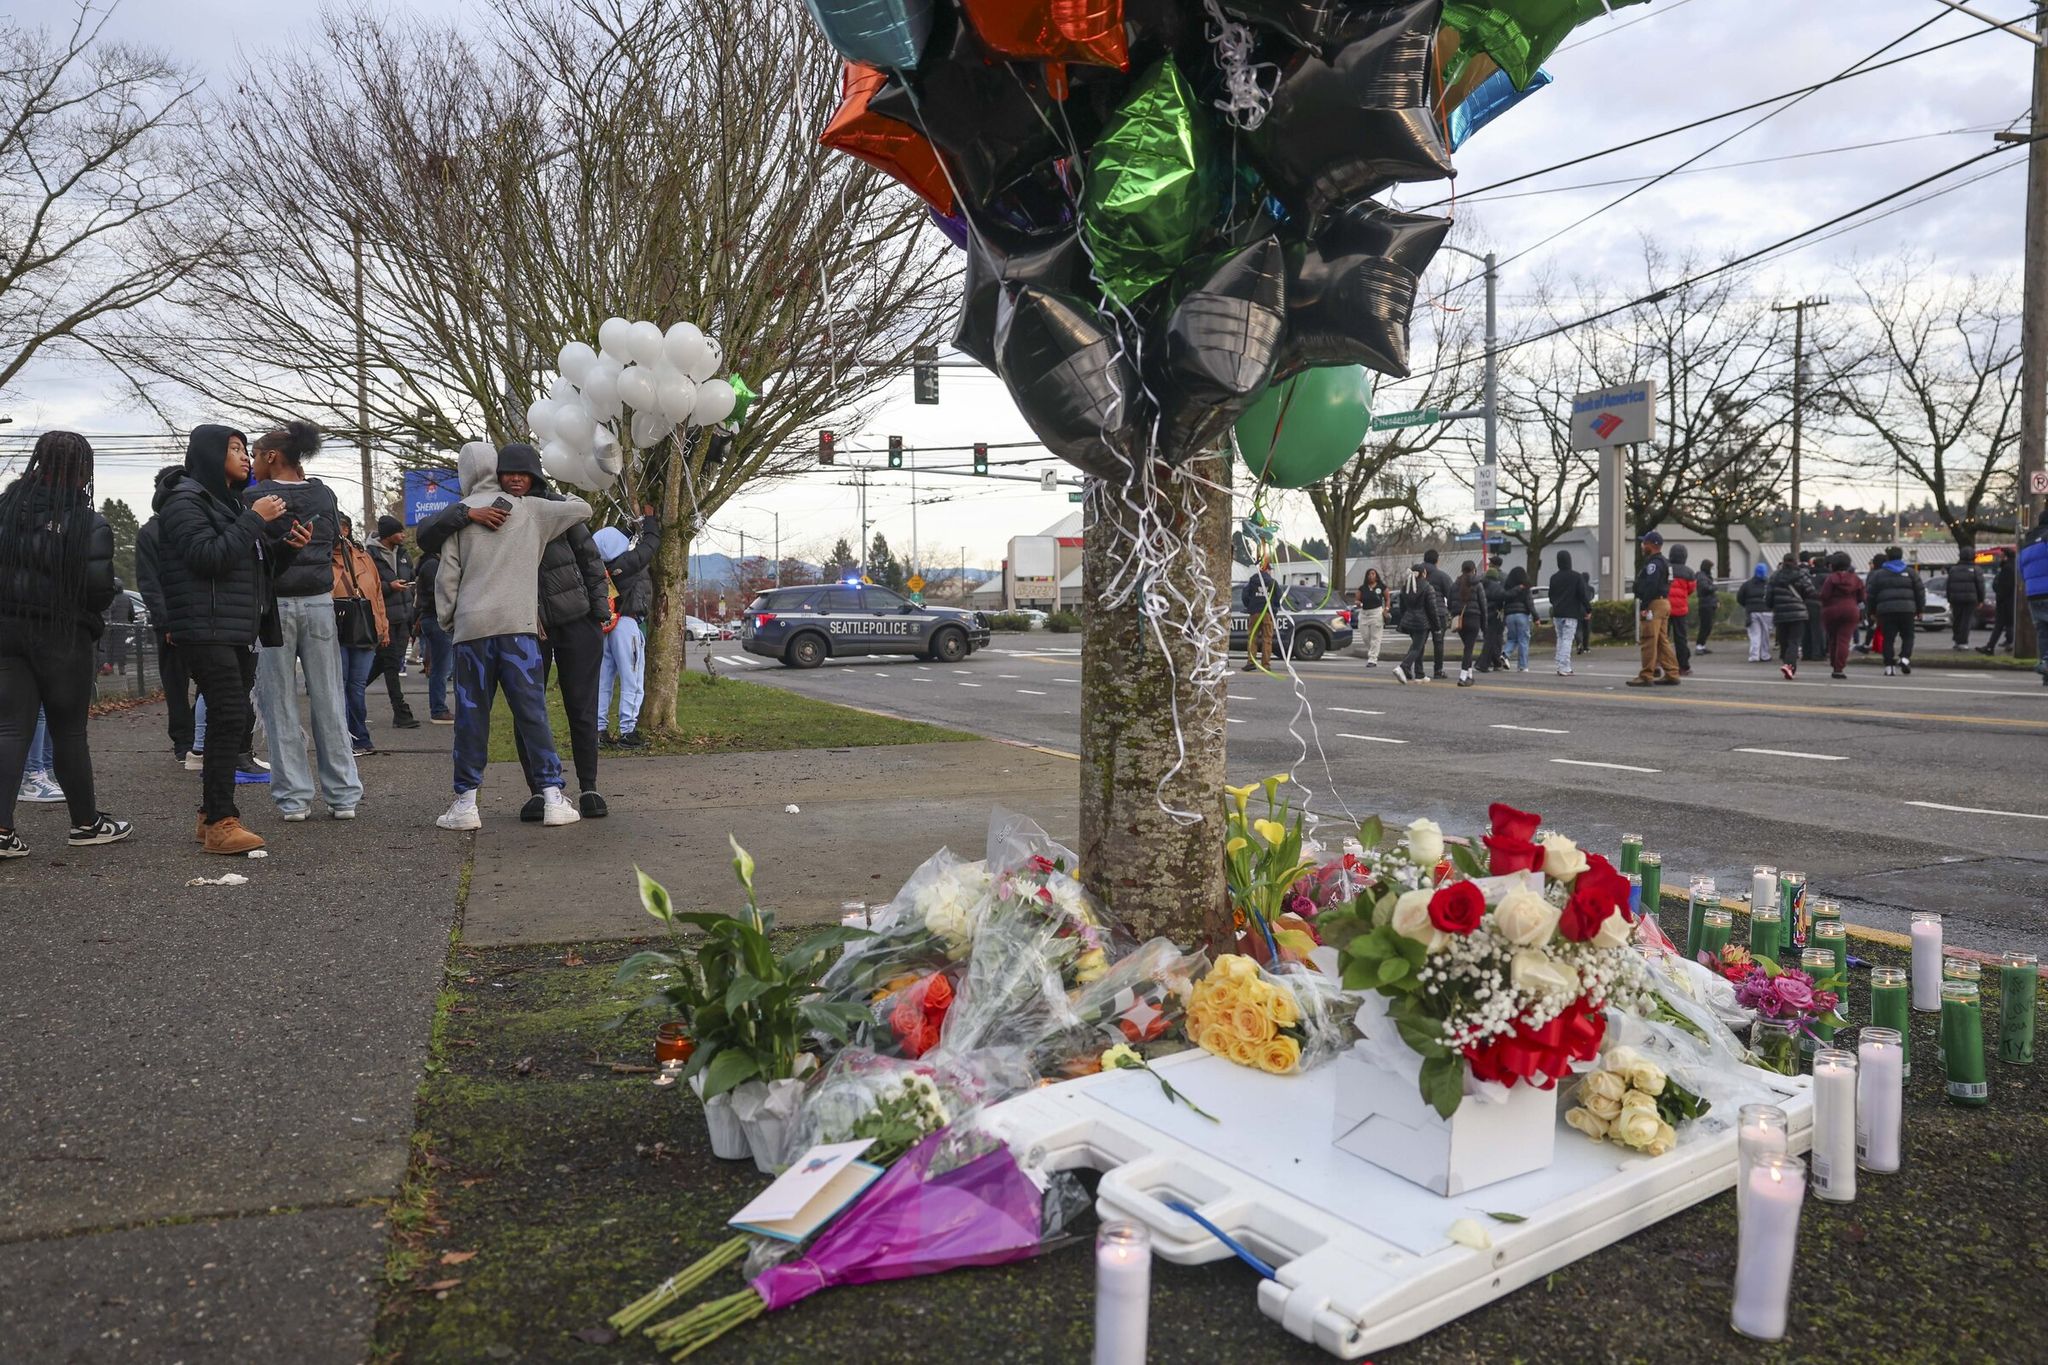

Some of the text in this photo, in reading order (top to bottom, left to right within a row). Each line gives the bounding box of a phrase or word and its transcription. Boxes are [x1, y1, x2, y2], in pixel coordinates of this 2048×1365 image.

[1574, 390, 1646, 413] Bank of America
[1379, 413, 1417, 427] Henderson
[1479, 469, 1491, 479] NO
[415, 501, 449, 512] SHERWIN
